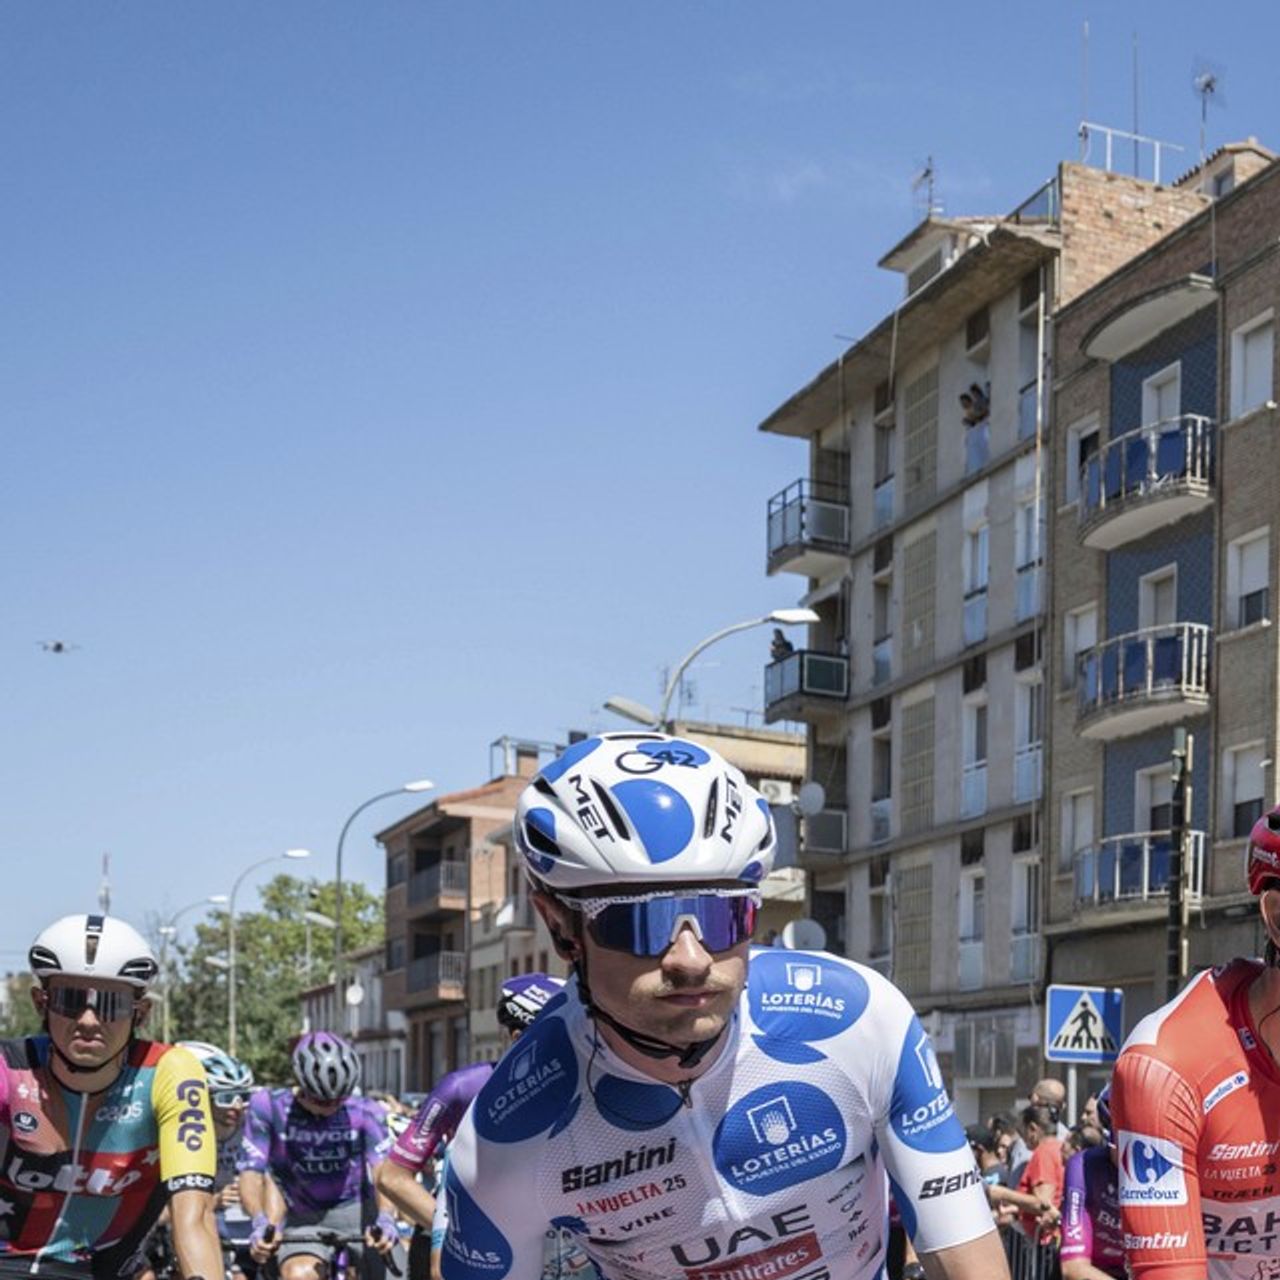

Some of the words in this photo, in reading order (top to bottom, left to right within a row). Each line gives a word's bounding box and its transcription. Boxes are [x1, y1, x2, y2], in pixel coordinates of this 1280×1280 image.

[569, 774, 615, 843] MET
[761, 992, 845, 1013] LOTERÍAS
[280, 1126, 359, 1144] Jayco
[731, 1128, 838, 1178] LOTERÍAS
[1207, 1140, 1280, 1162] Santini
[8, 1157, 141, 1195] lotto
[561, 1137, 678, 1194] Santini
[598, 1182, 663, 1214] VUELTA
[663, 1174, 687, 1195] 25
[620, 1206, 677, 1233] VINE
[670, 1204, 815, 1267] UAE
[1123, 1232, 1189, 1249] Santini
